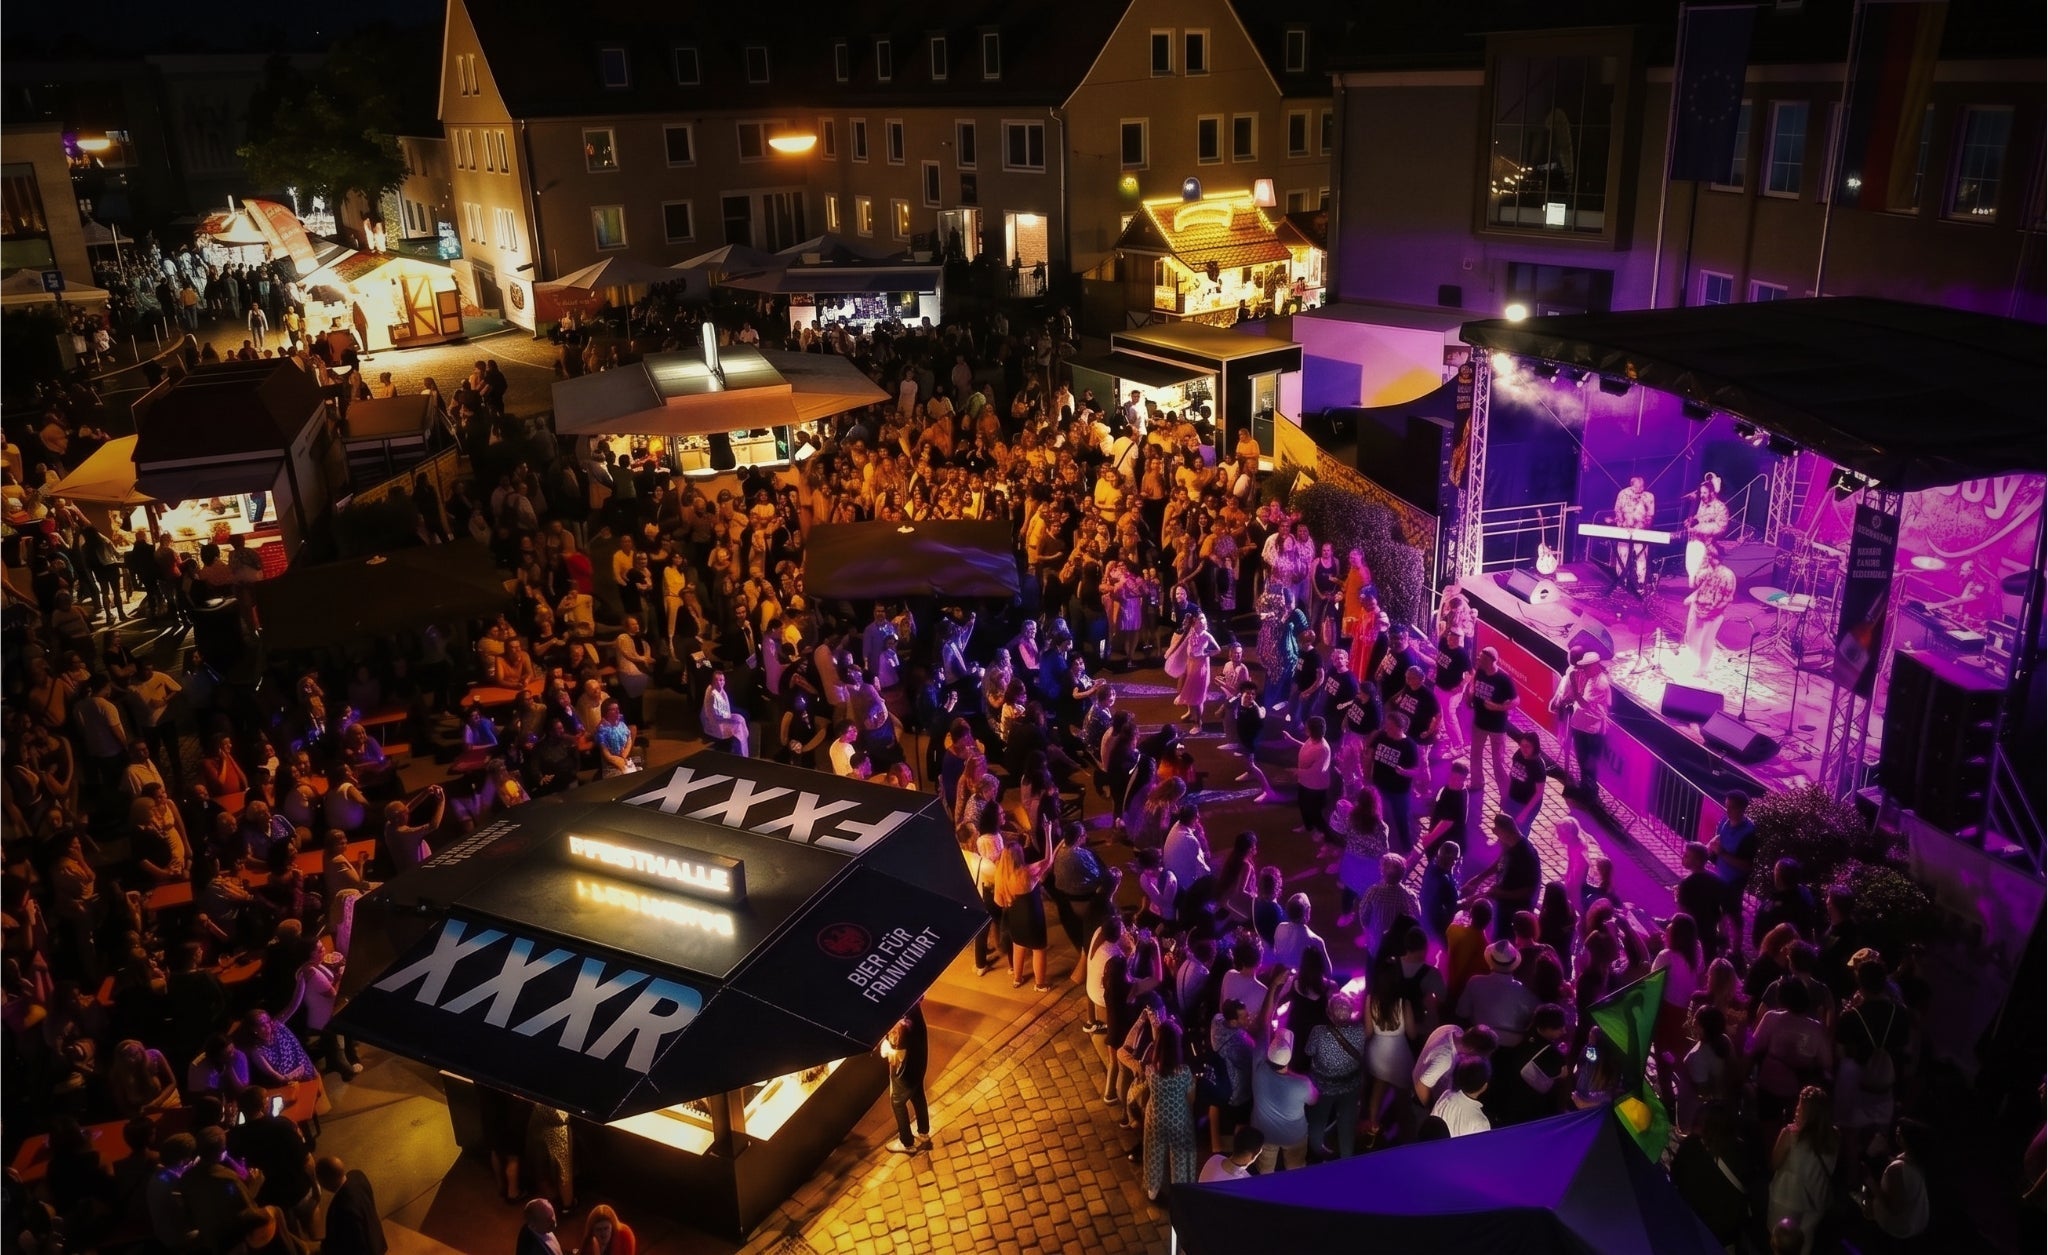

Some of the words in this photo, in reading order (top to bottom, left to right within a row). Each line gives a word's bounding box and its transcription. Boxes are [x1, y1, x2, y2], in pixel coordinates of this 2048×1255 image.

[372, 917, 703, 1074] XXXR
[847, 953, 888, 988] BIER
[877, 927, 914, 956] FÜR
